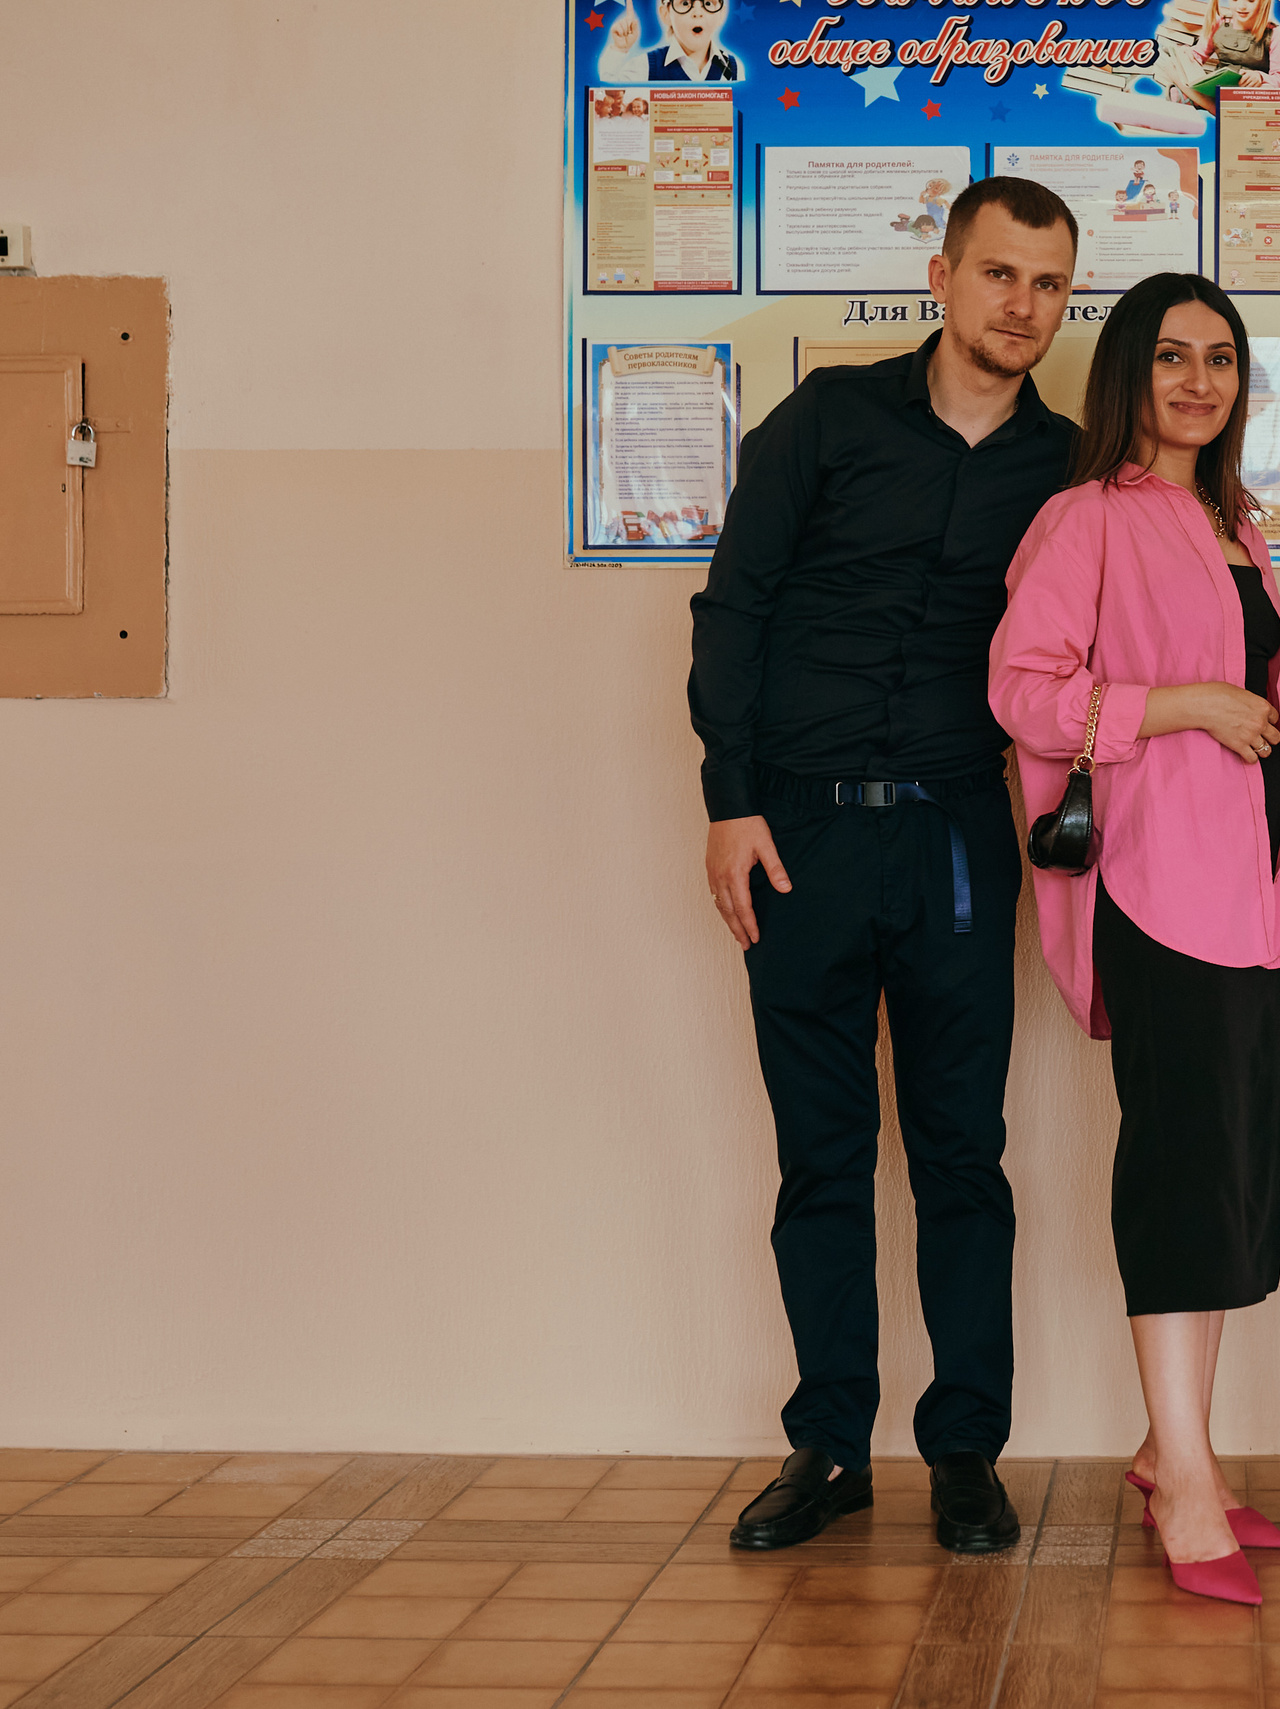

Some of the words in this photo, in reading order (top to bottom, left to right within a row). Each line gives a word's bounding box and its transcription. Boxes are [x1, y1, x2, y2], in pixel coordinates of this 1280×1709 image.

[770, 15, 890, 71] общее
[898, 15, 1156, 83] образование
[846, 161, 863, 169] для
[865, 160, 915, 169] родителей:
[844, 300, 909, 325] Для
[623, 351, 653, 361] Советы
[655, 351, 699, 361] родителям
[627, 360, 697, 370] первоклассников
